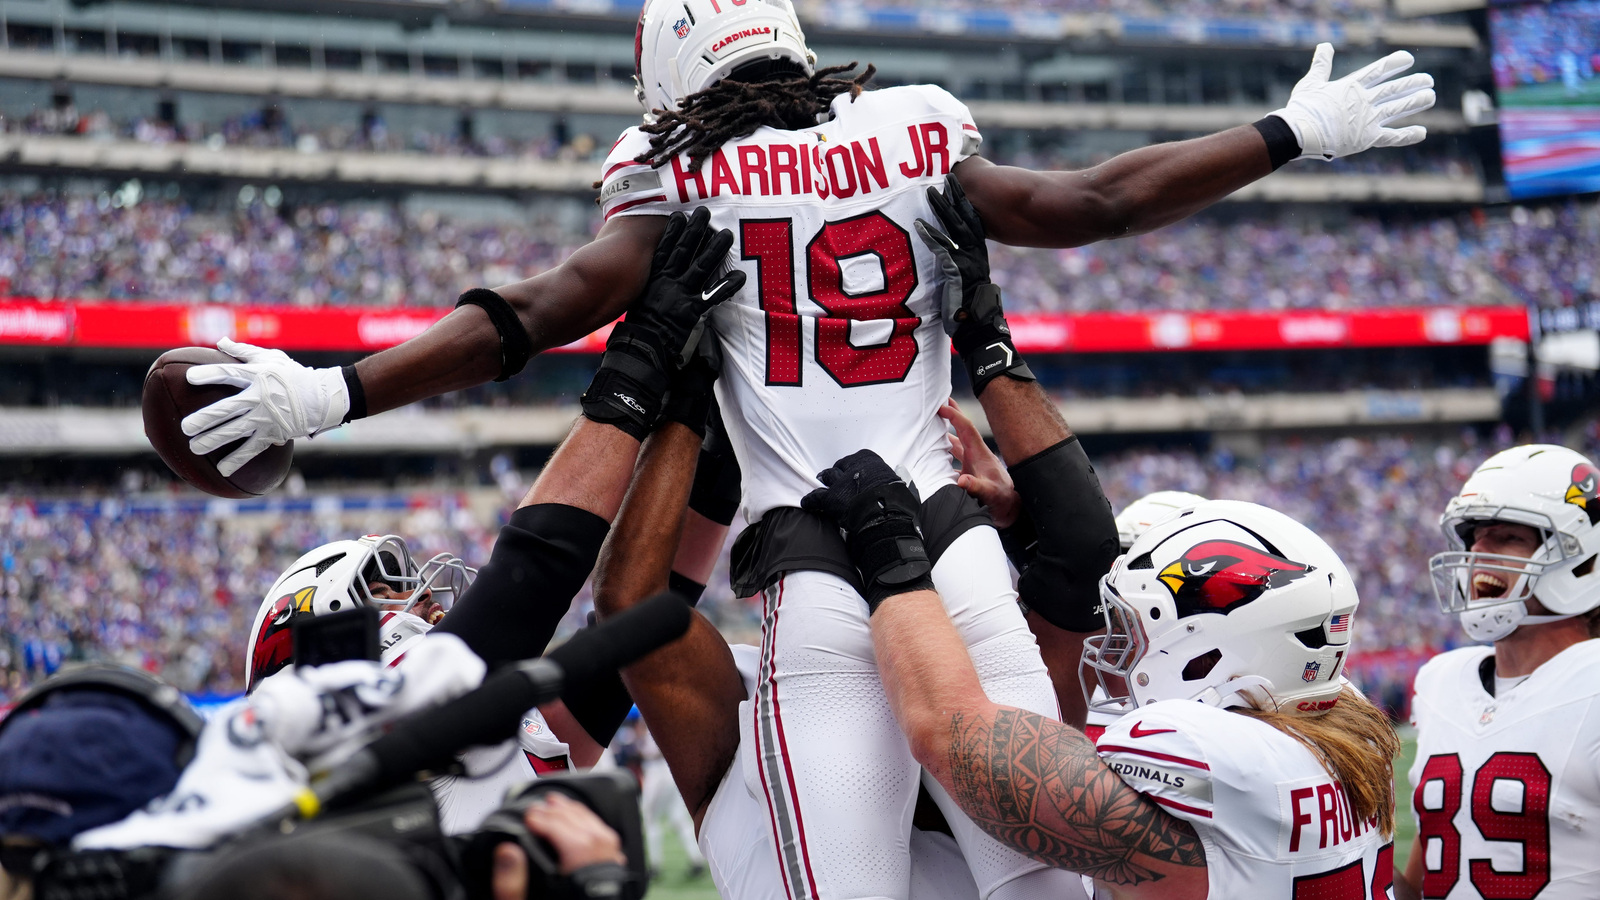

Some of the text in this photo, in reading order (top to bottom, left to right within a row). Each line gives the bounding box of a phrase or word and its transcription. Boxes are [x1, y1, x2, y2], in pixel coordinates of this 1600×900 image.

[711, 27, 771, 52] CARDINALS
[670, 121, 950, 203] HARRISON JR
[740, 210, 922, 388] 18
[1303, 669, 1317, 681] NFL
[1413, 752, 1552, 900] 89
